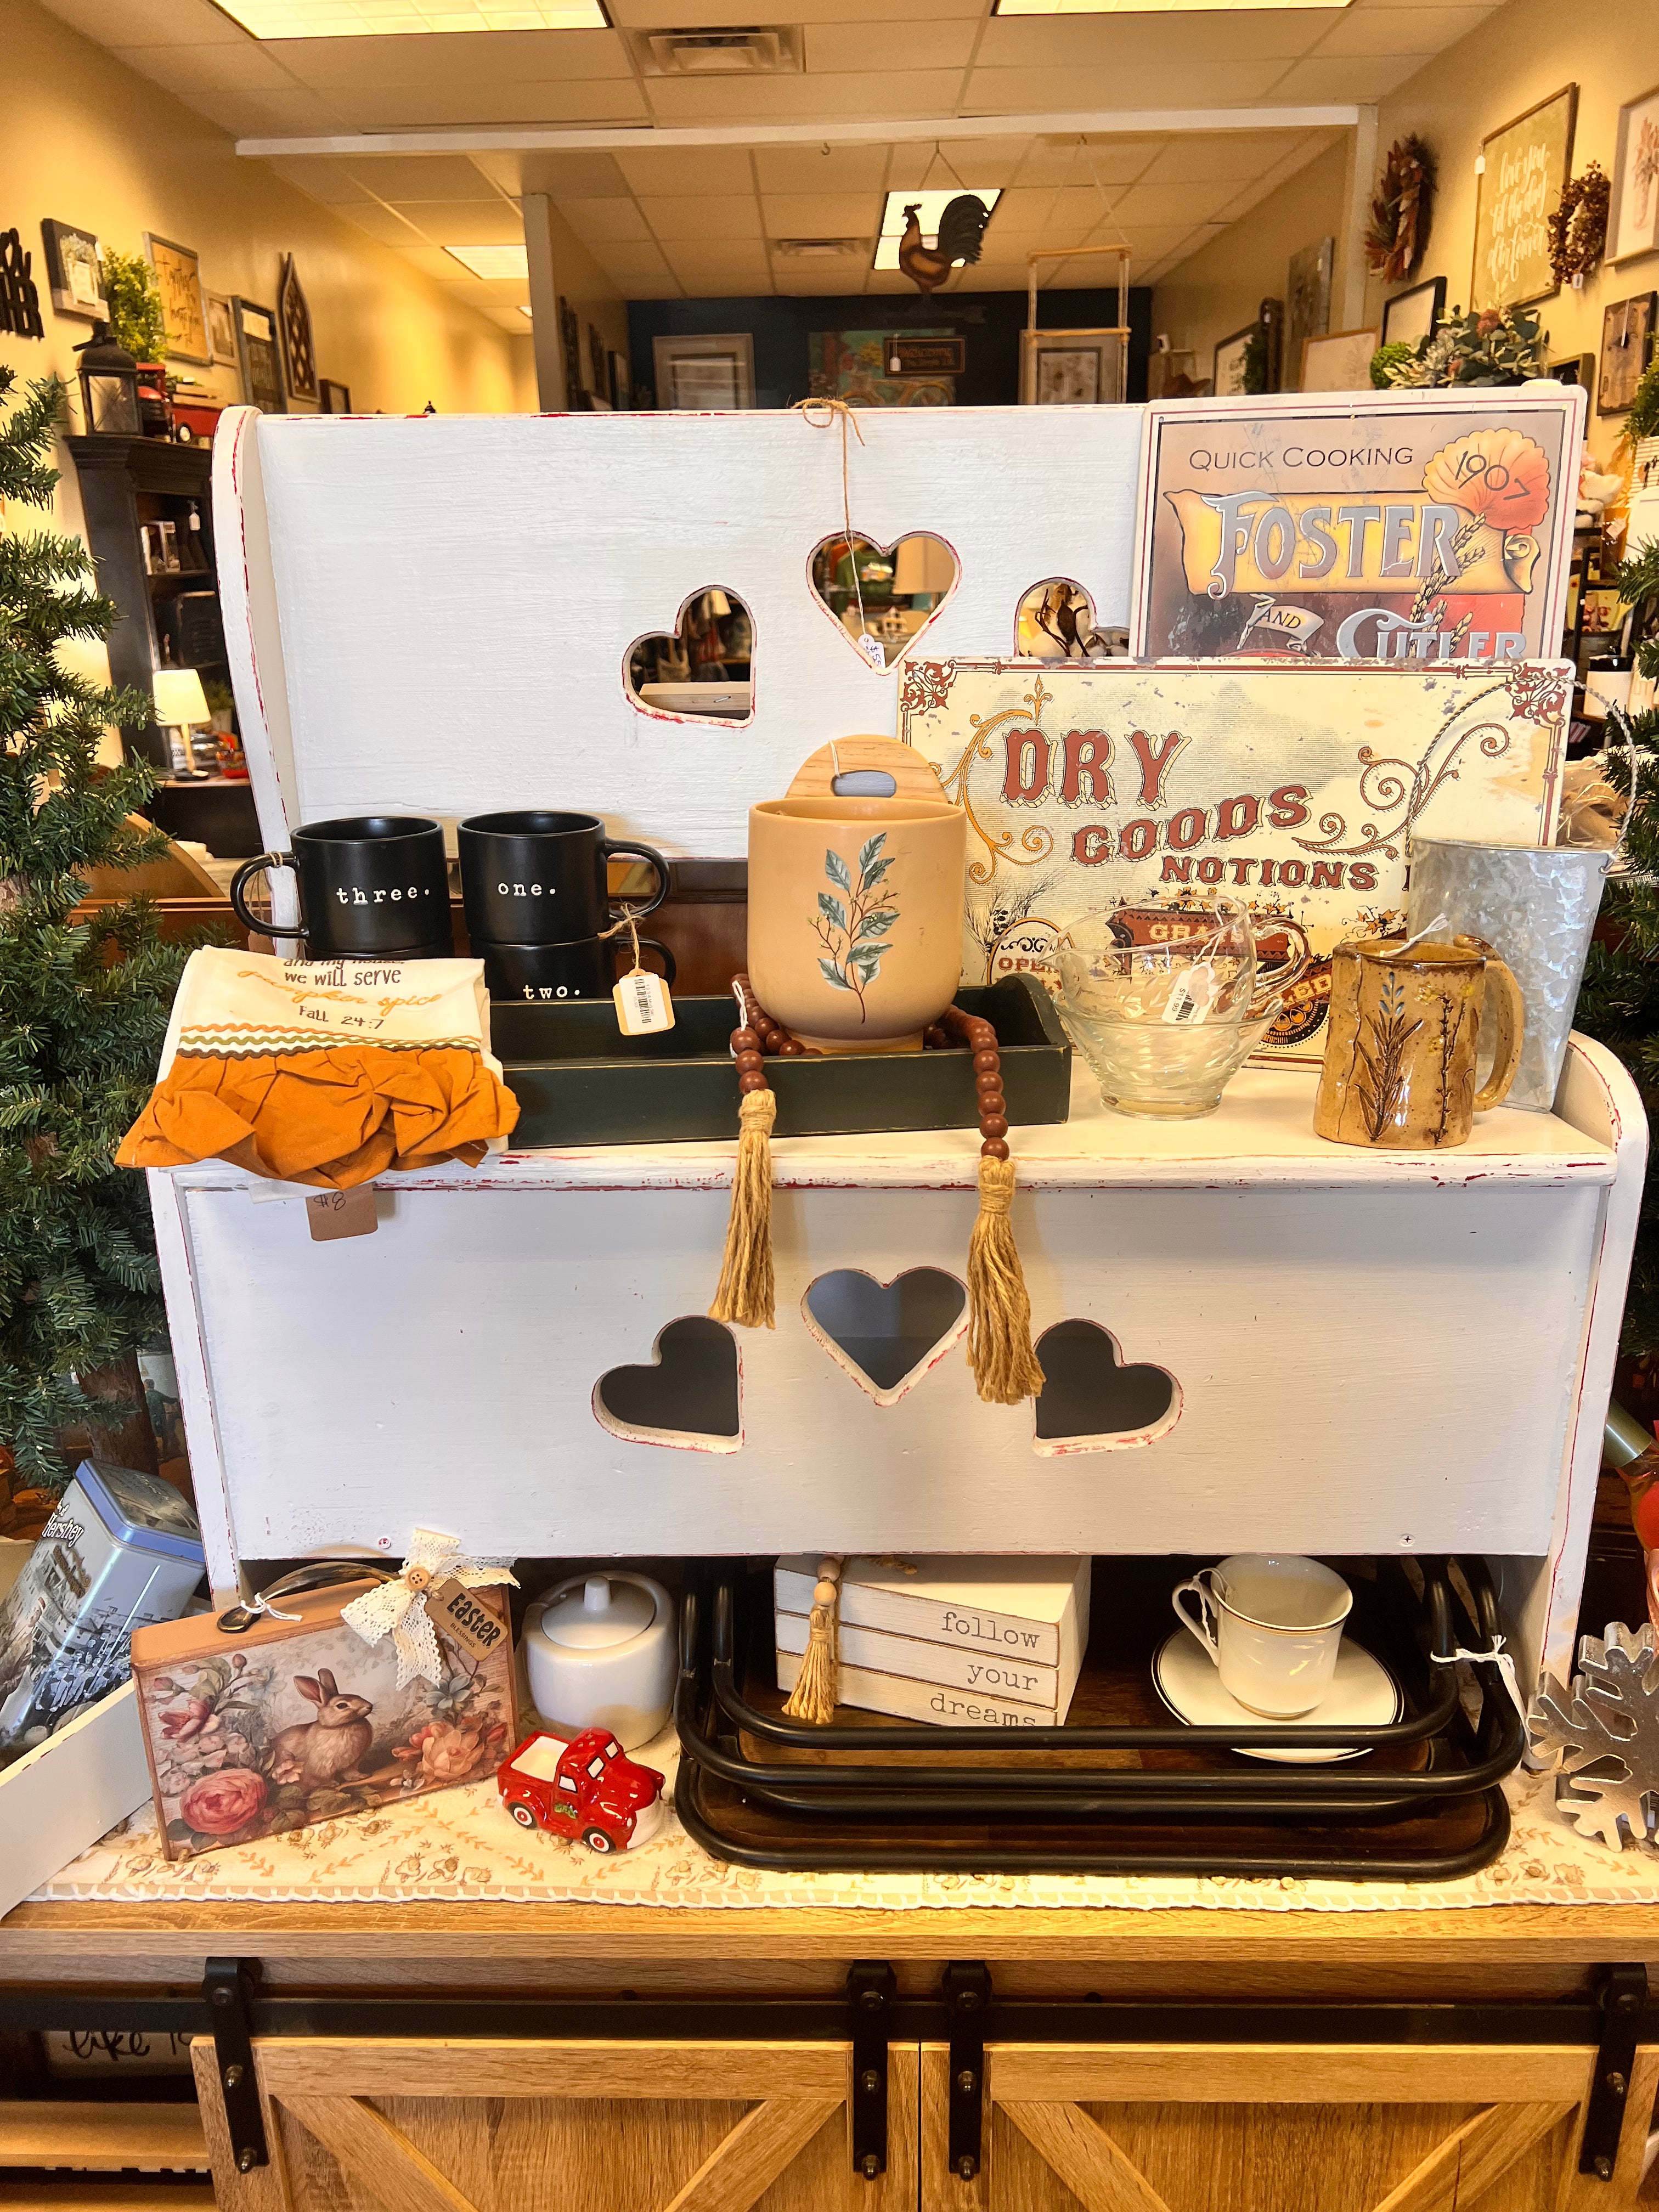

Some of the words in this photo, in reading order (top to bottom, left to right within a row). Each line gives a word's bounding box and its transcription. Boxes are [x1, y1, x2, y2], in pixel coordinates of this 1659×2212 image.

[1189, 448, 1272, 472] QUICK
[1283, 447, 1414, 468] COOKING
[1455, 450, 1531, 500] 1907
[1200, 490, 1462, 600] FOSTER
[1262, 610, 1302, 630] AND
[1000, 727, 1192, 811] DRY
[1070, 784, 1314, 868] GOODS
[1160, 854, 1379, 891] NOTIONS
[336, 887, 430, 905] three.
[498, 882, 556, 896] one.
[284, 972, 307, 984] we
[314, 968, 347, 987] will
[353, 968, 402, 986] serve
[522, 984, 580, 1000] two.
[1172, 988, 1186, 1012] $11.99
[298, 1005, 329, 1023] Fall
[313, 1191, 347, 1211] $8
[41, 1511, 85, 1548] Hershey
[449, 1622, 477, 1649] BLESSINGS
[941, 1611, 1041, 1649] follow
[967, 1664, 1039, 1691] your
[930, 1692, 1036, 1727] dreams
